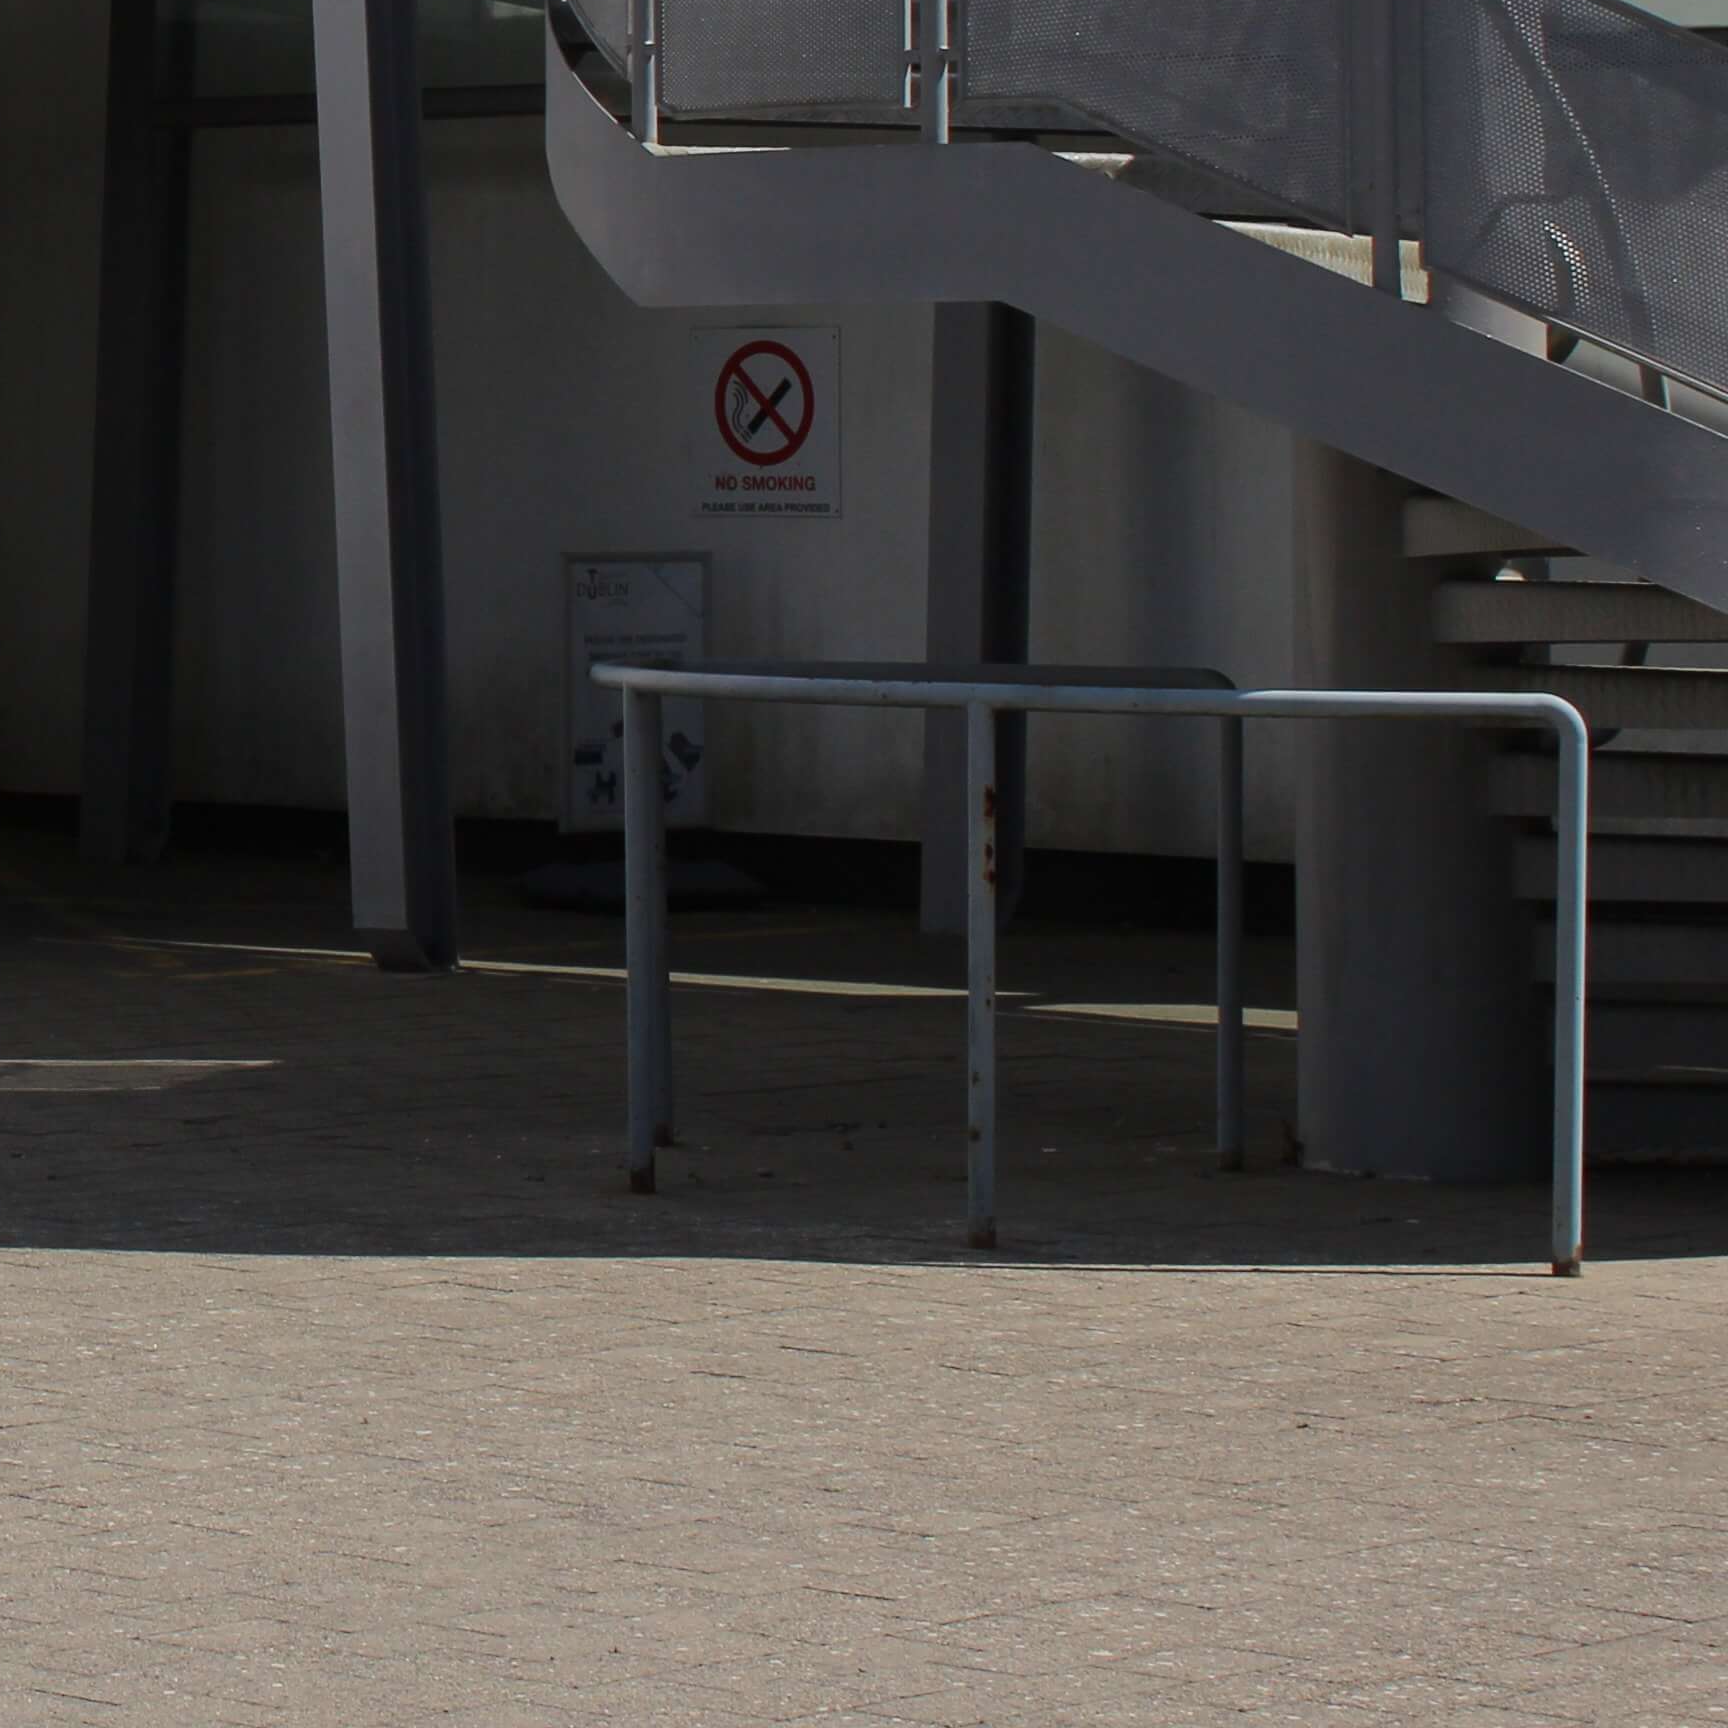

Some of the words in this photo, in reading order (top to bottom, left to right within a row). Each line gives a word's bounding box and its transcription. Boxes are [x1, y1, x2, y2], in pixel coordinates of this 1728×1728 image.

[715, 476, 738, 491] NO
[741, 476, 816, 491] SMOKING
[702, 503, 736, 512] PLEASE
[758, 503, 783, 512] AREA
